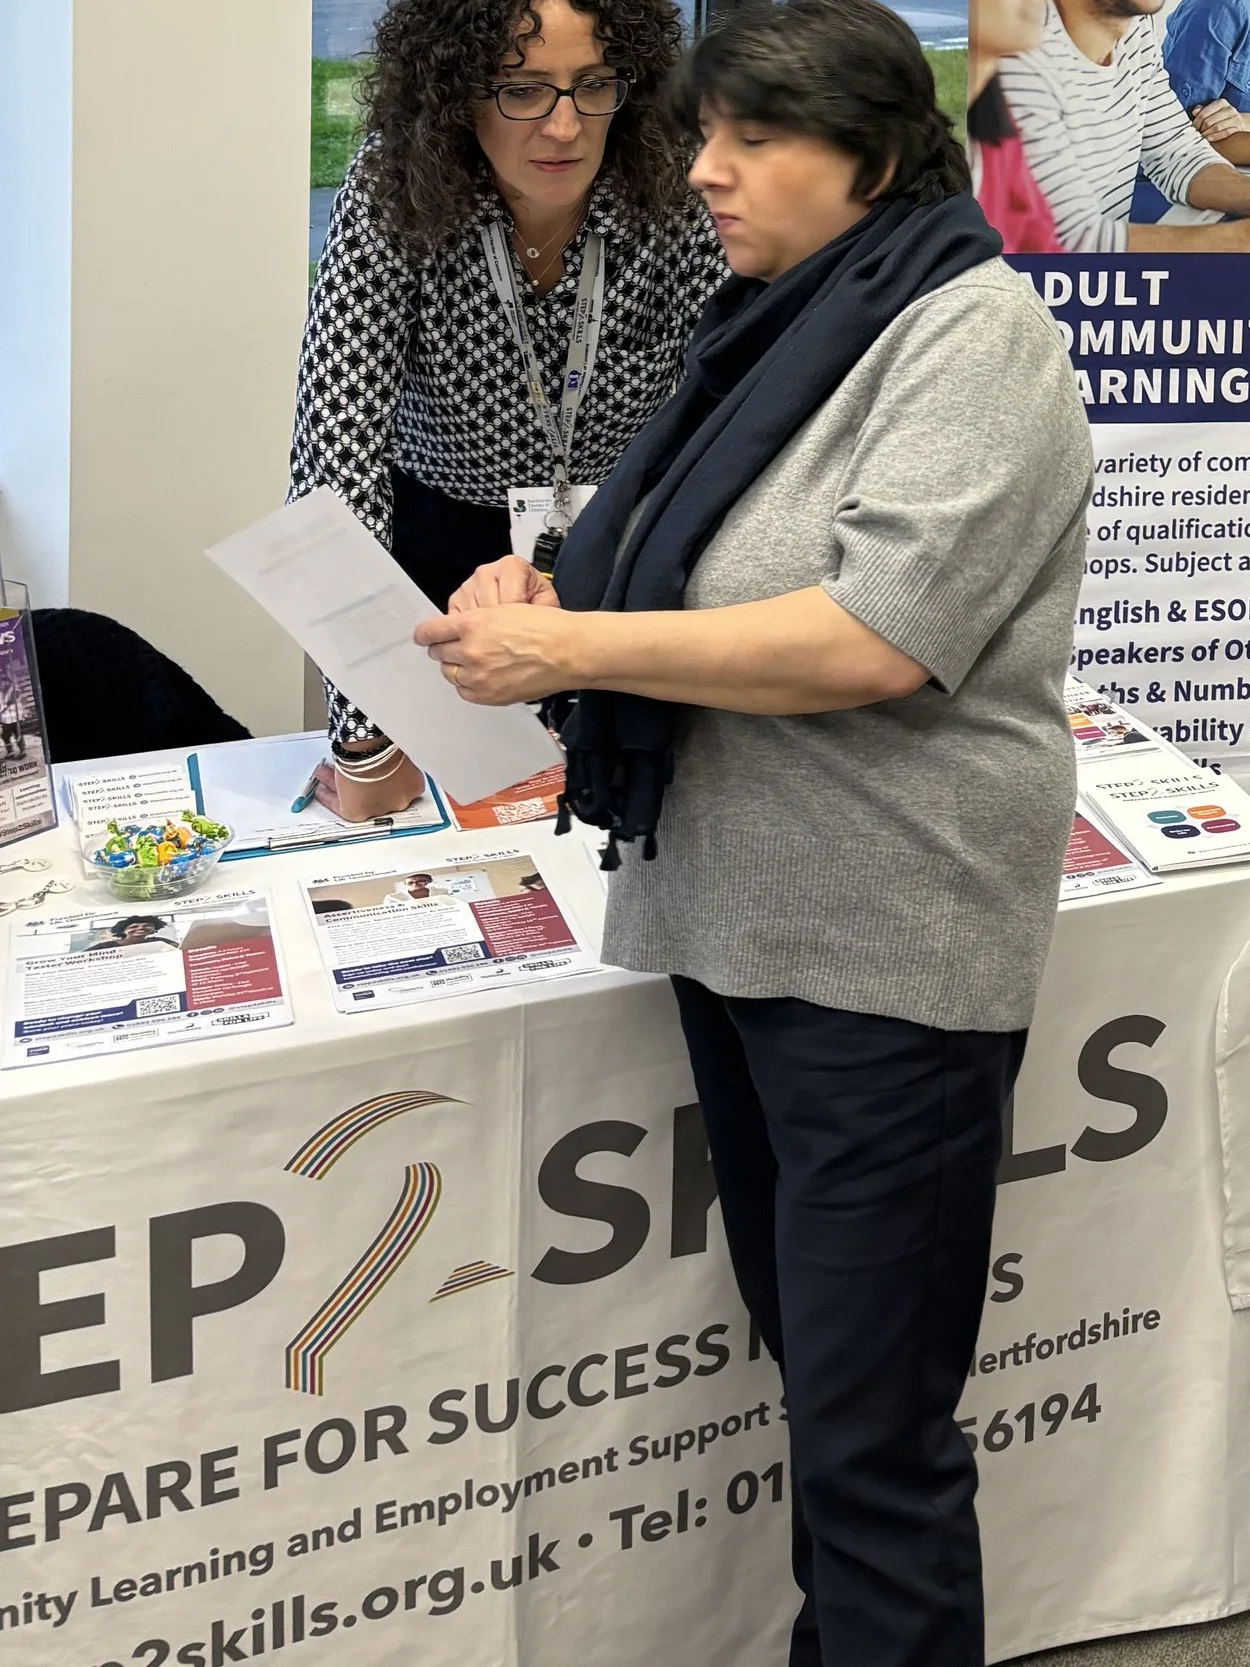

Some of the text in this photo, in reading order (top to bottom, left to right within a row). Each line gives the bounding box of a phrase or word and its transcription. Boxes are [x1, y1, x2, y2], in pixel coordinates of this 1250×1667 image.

[1074, 367, 1249, 404] ARNING
[1178, 451, 1203, 472] of
[1092, 485, 1165, 507] dshire
[1097, 519, 1122, 541] of
[1083, 557, 1137, 580] ops.
[1144, 551, 1232, 578] Subject
[1073, 599, 1160, 631] nglish
[1167, 600, 1187, 623] &
[1191, 638, 1220, 661] of
[1146, 681, 1166, 703] &
[1153, 717, 1244, 746] ability
[0, 1445, 240, 1552] EPARE
[264, 1405, 409, 1490] FOR
[427, 1324, 730, 1444] SUCCESS
[0, 1592, 78, 1630] nity
[91, 1542, 274, 1607] Learning
[287, 1507, 361, 1557] and
[375, 1447, 619, 1534] Employment
[628, 1402, 770, 1466] Support
[92, 1533, 561, 1667] 2skills.org.uk
[609, 1488, 707, 1550] Tel:
[727, 1462, 783, 1514] 01
